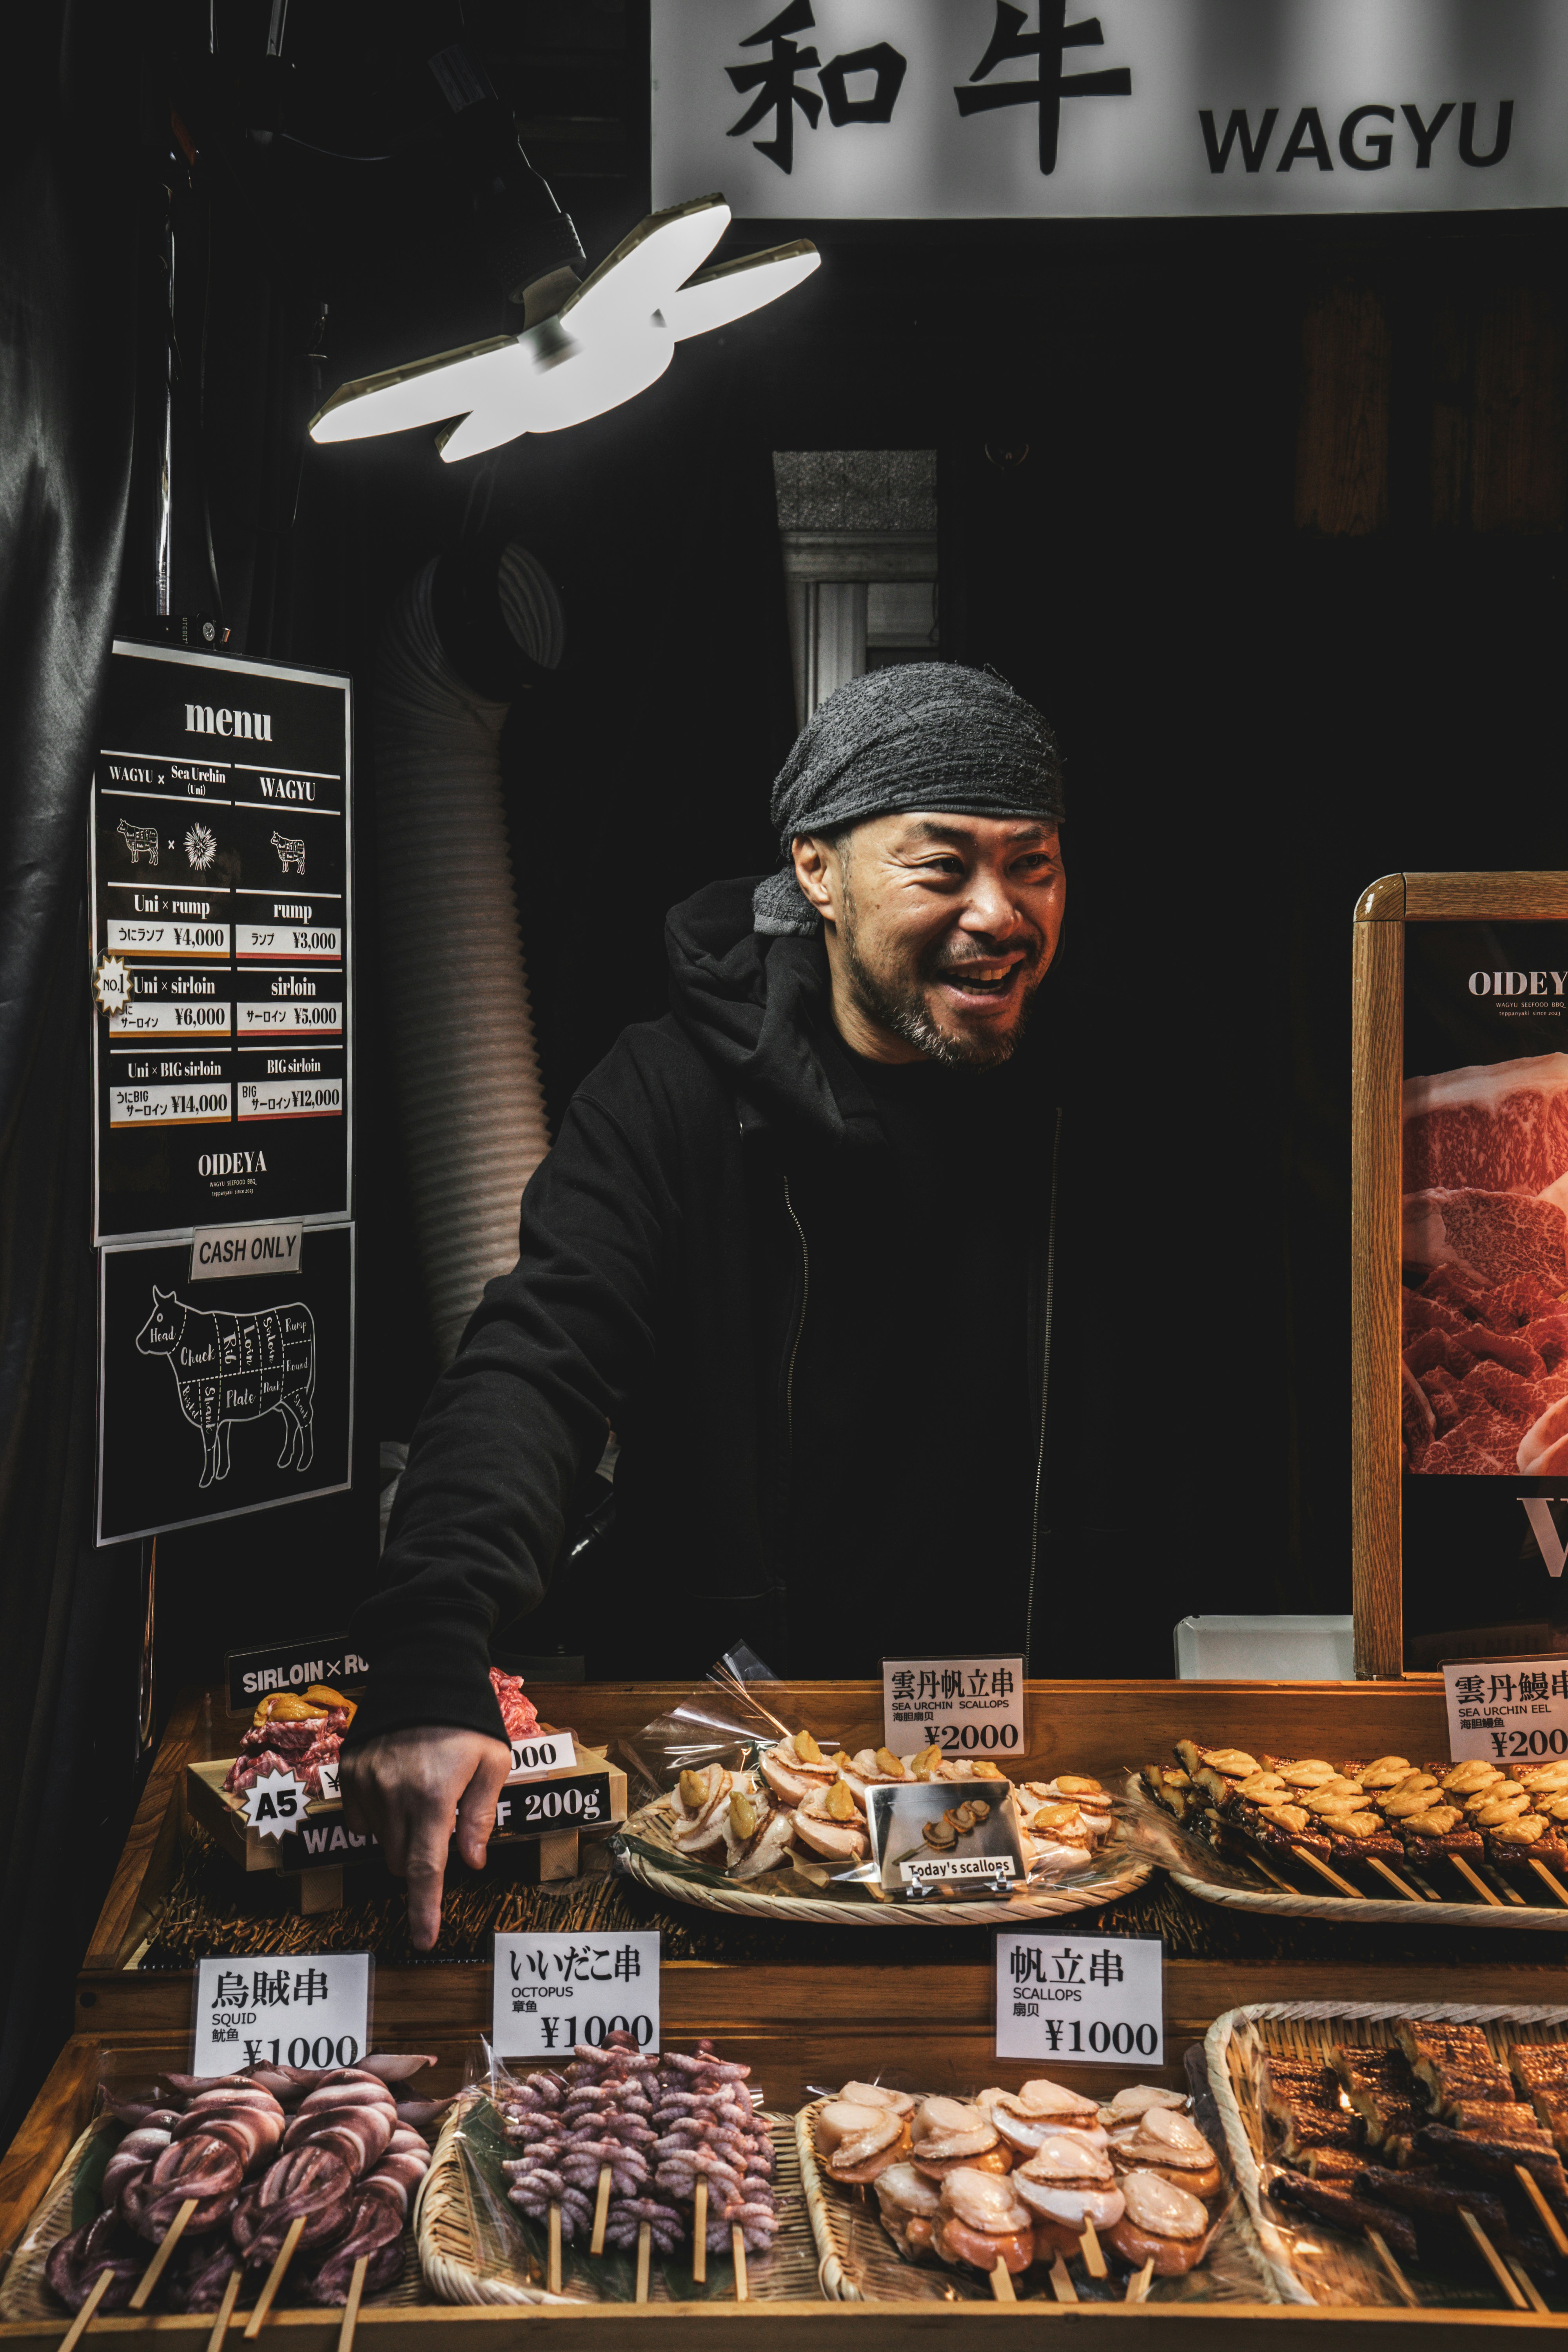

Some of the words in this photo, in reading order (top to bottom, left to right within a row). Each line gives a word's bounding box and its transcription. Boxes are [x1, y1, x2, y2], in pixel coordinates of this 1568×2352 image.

[724, 0, 1132, 176] 和牛
[1198, 98, 1515, 174] WAGYU
[185, 704, 273, 742] menu
[109, 766, 153, 783] WAGYU
[171, 765, 190, 780] Sea
[191, 767, 226, 784] Urchin
[187, 783, 206, 796] (Uni)
[259, 777, 316, 802] WAGYU
[134, 894, 159, 912] Uni
[172, 901, 210, 920] rump
[274, 904, 312, 924] rump
[118, 927, 164, 942] うにランプ
[174, 928, 224, 947] ¥4,000
[251, 933, 275, 946] ランプ
[292, 932, 336, 951] ¥3,000
[103, 973, 125, 994] NO.1
[134, 976, 158, 994] Uni
[171, 976, 215, 994] sirloin
[271, 976, 316, 996] sirloin
[119, 1005, 133, 1015] に
[121, 1017, 158, 1028] サーロイン
[174, 1008, 225, 1028] ¥6,000
[247, 1010, 286, 1022] サーロイン
[294, 1008, 337, 1026] ¥5,000
[128, 1062, 149, 1078] Uni
[161, 1062, 182, 1077] BIG
[184, 1060, 221, 1076] sirloin
[267, 1059, 286, 1073] BIG
[288, 1058, 321, 1073] sirloin
[242, 1085, 257, 1098] BIG
[251, 1098, 290, 1111] サーロイン
[291, 1089, 339, 1108] ¥12,000
[126, 1103, 167, 1117] サーロイン
[171, 1094, 227, 1115] ¥14,000
[198, 1151, 267, 1176] OIDEYA
[199, 1239, 247, 1265] CASH
[251, 1235, 297, 1260] ONLY
[150, 1325, 176, 1343] Head
[285, 1318, 307, 1333] Rump
[223, 1331, 237, 1364] Rib
[243, 1324, 255, 1366] Loin
[263, 1317, 276, 1364] Sirloin
[180, 1343, 216, 1367] Chuck
[286, 1357, 309, 1372] Round
[226, 1388, 256, 1408] Plate
[204, 1387, 216, 1434] Shank
[243, 1660, 323, 1693] SIRLOIN
[345, 1654, 369, 1675] RU
[891, 1668, 1014, 1700] 雲丹帆立串
[892, 1702, 911, 1711] SEA
[914, 1701, 953, 1710] URCHIN
[959, 1700, 1009, 1709] SCALLOPS
[1458, 1708, 1480, 1717] SEA
[1483, 1705, 1527, 1716] URCHIN
[1531, 1704, 1552, 1713] EEL
[893, 1711, 934, 1722] 海胆扇贝
[924, 1724, 1018, 1750] ¥2000
[510, 1742, 557, 1771] 000
[255, 1789, 298, 1822] A5
[525, 1789, 600, 1821] 200g
[908, 1861, 957, 1877] Today's
[509, 1944, 641, 1982] いいだこ串
[1010, 1945, 1124, 1987] 帆立串
[511, 1986, 573, 1998] OCTOPUS
[1013, 1987, 1082, 2002] SCALLOPS
[512, 2000, 538, 2013] 章鱼
[1013, 2002, 1039, 2017] 扇贝
[212, 2013, 257, 2027] SQUID
[212, 2027, 240, 2042] 鱿鱼
[1045, 2020, 1158, 2056] ¥1000
[243, 2035, 359, 2069] ¥1000
